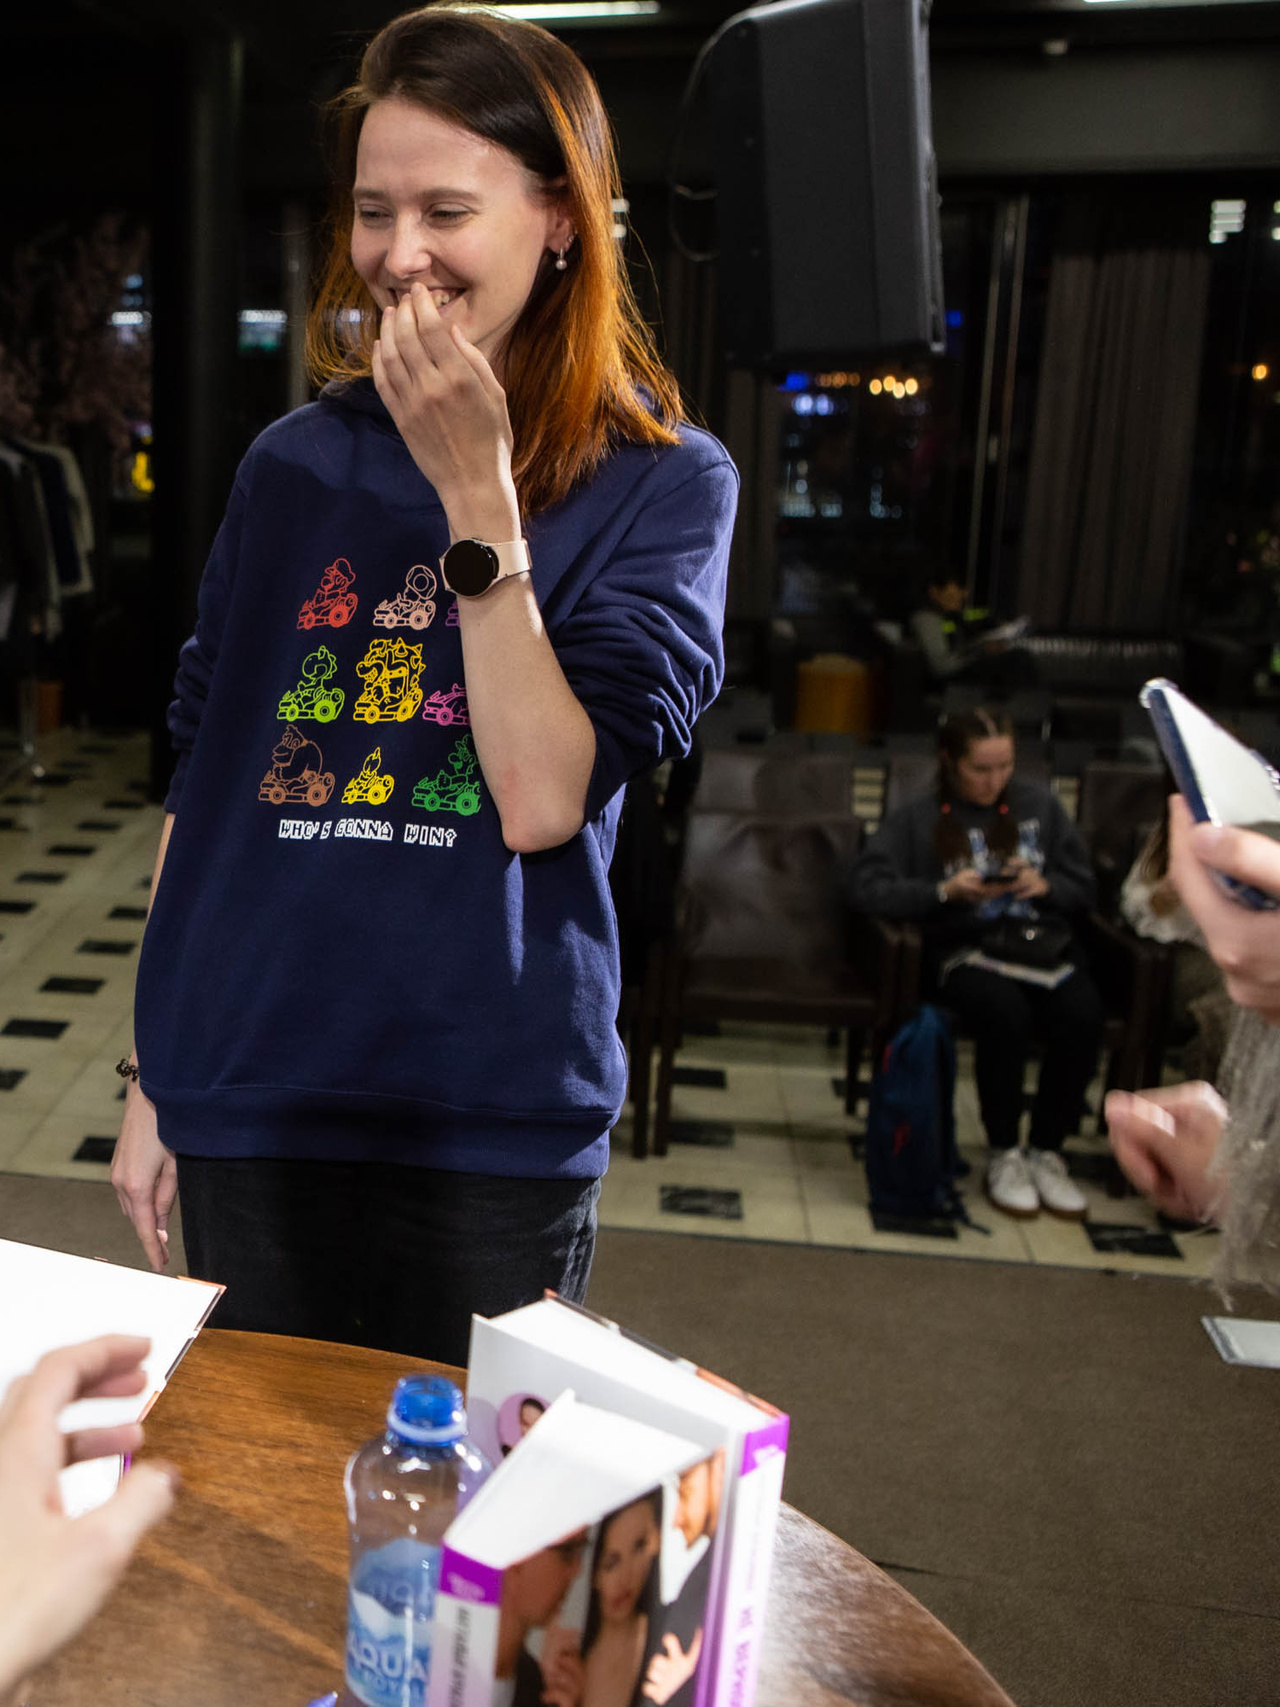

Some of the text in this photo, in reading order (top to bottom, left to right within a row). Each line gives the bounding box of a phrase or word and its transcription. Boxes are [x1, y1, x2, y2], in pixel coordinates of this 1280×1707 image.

[278, 818, 458, 848] WHO'S GONNA WIN?
